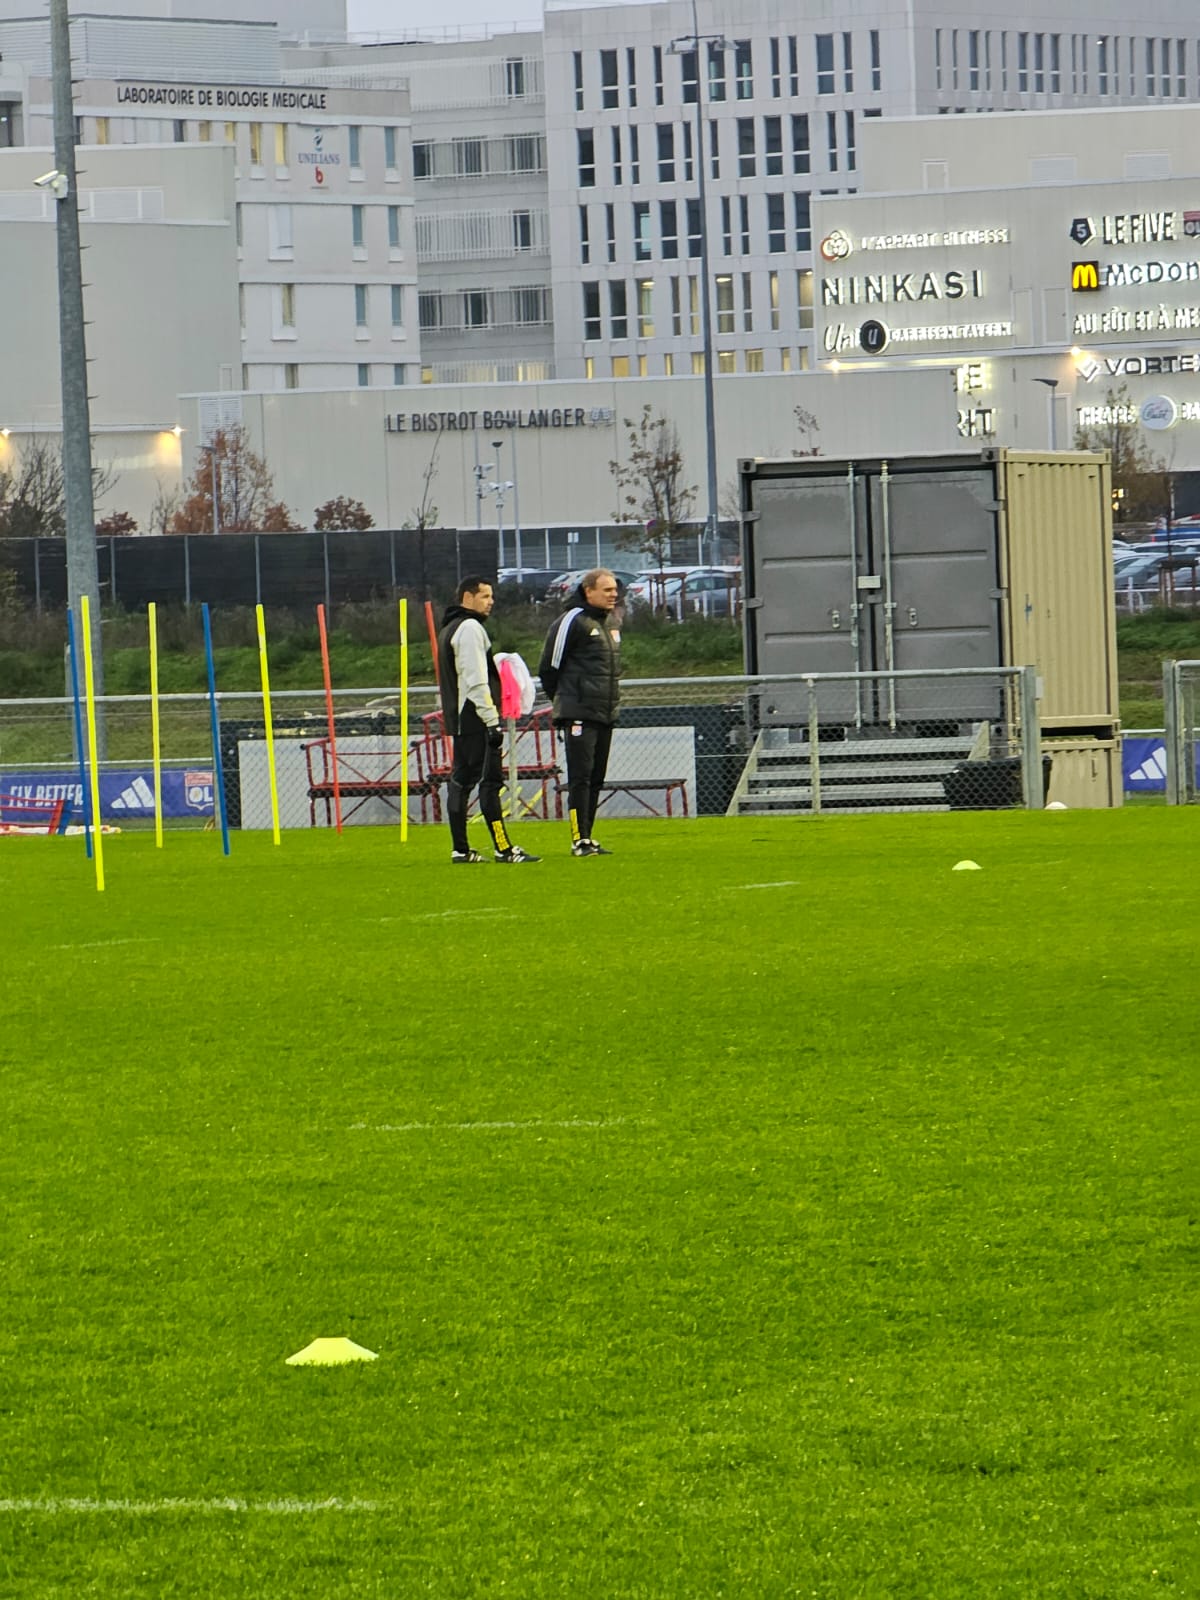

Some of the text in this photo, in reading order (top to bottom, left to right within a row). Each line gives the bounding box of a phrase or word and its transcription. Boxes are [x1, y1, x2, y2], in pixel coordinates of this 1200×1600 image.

[117, 86, 327, 110] LABORATOIRE DE BIOLOGIE MEDICALE
[1076, 223, 1087, 239] 5
[1103, 212, 1177, 245] LE FIVE
[821, 269, 985, 306] NINKASI
[1073, 313, 1097, 335] AU
[1135, 311, 1154, 331] ET
[1104, 354, 1200, 377] VORTE
[387, 413, 406, 433] LE
[411, 411, 478, 432] BISTROT
[482, 408, 586, 430] BOULANGER
[8, 783, 84, 808] FLY BETTER
[189, 786, 214, 803] OL
